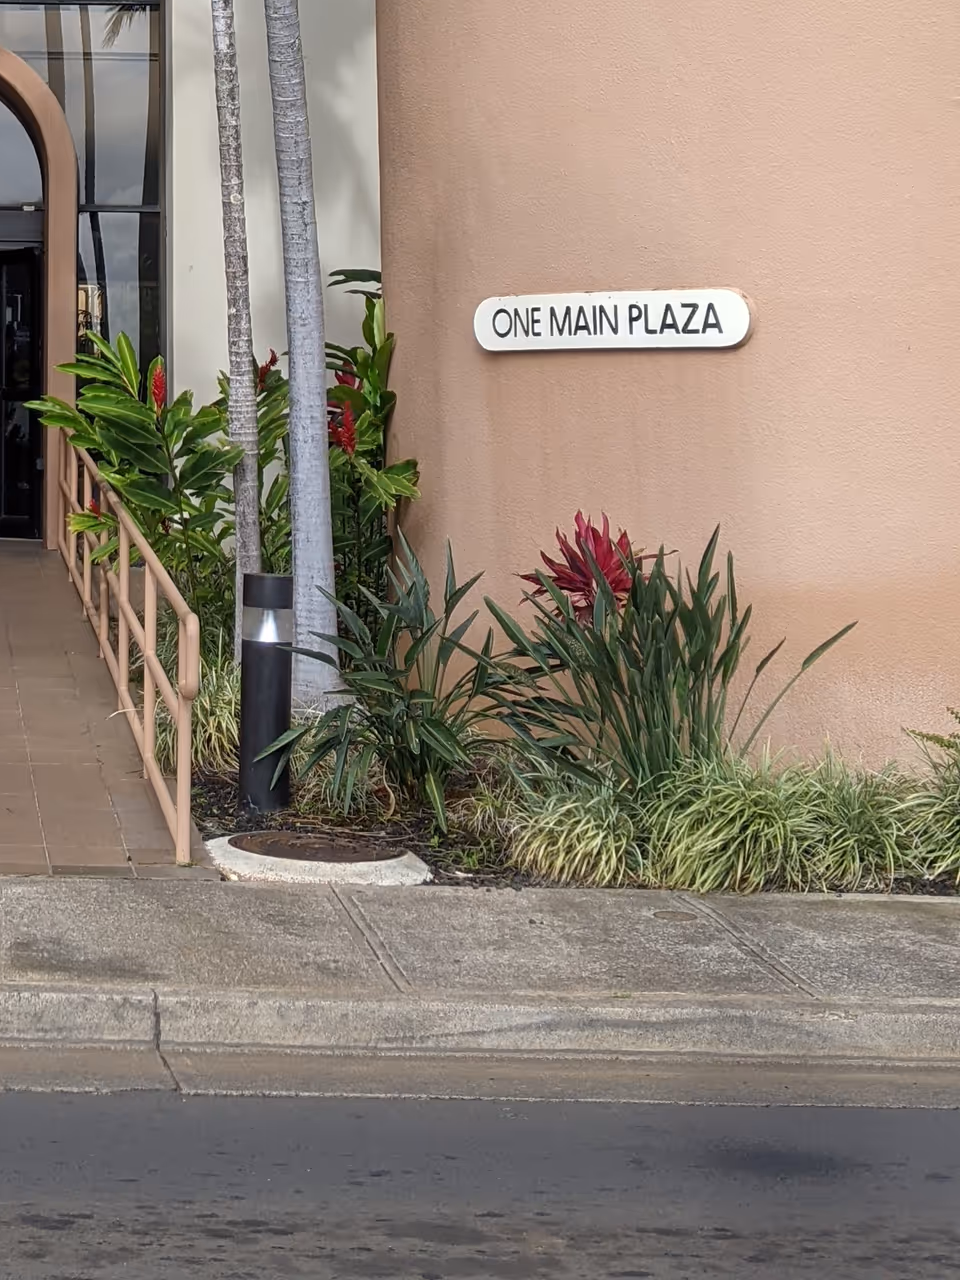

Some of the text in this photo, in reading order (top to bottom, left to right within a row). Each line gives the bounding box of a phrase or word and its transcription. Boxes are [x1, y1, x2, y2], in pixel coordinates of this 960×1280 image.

[492, 302, 724, 339] ONE MAIN PLAZA
